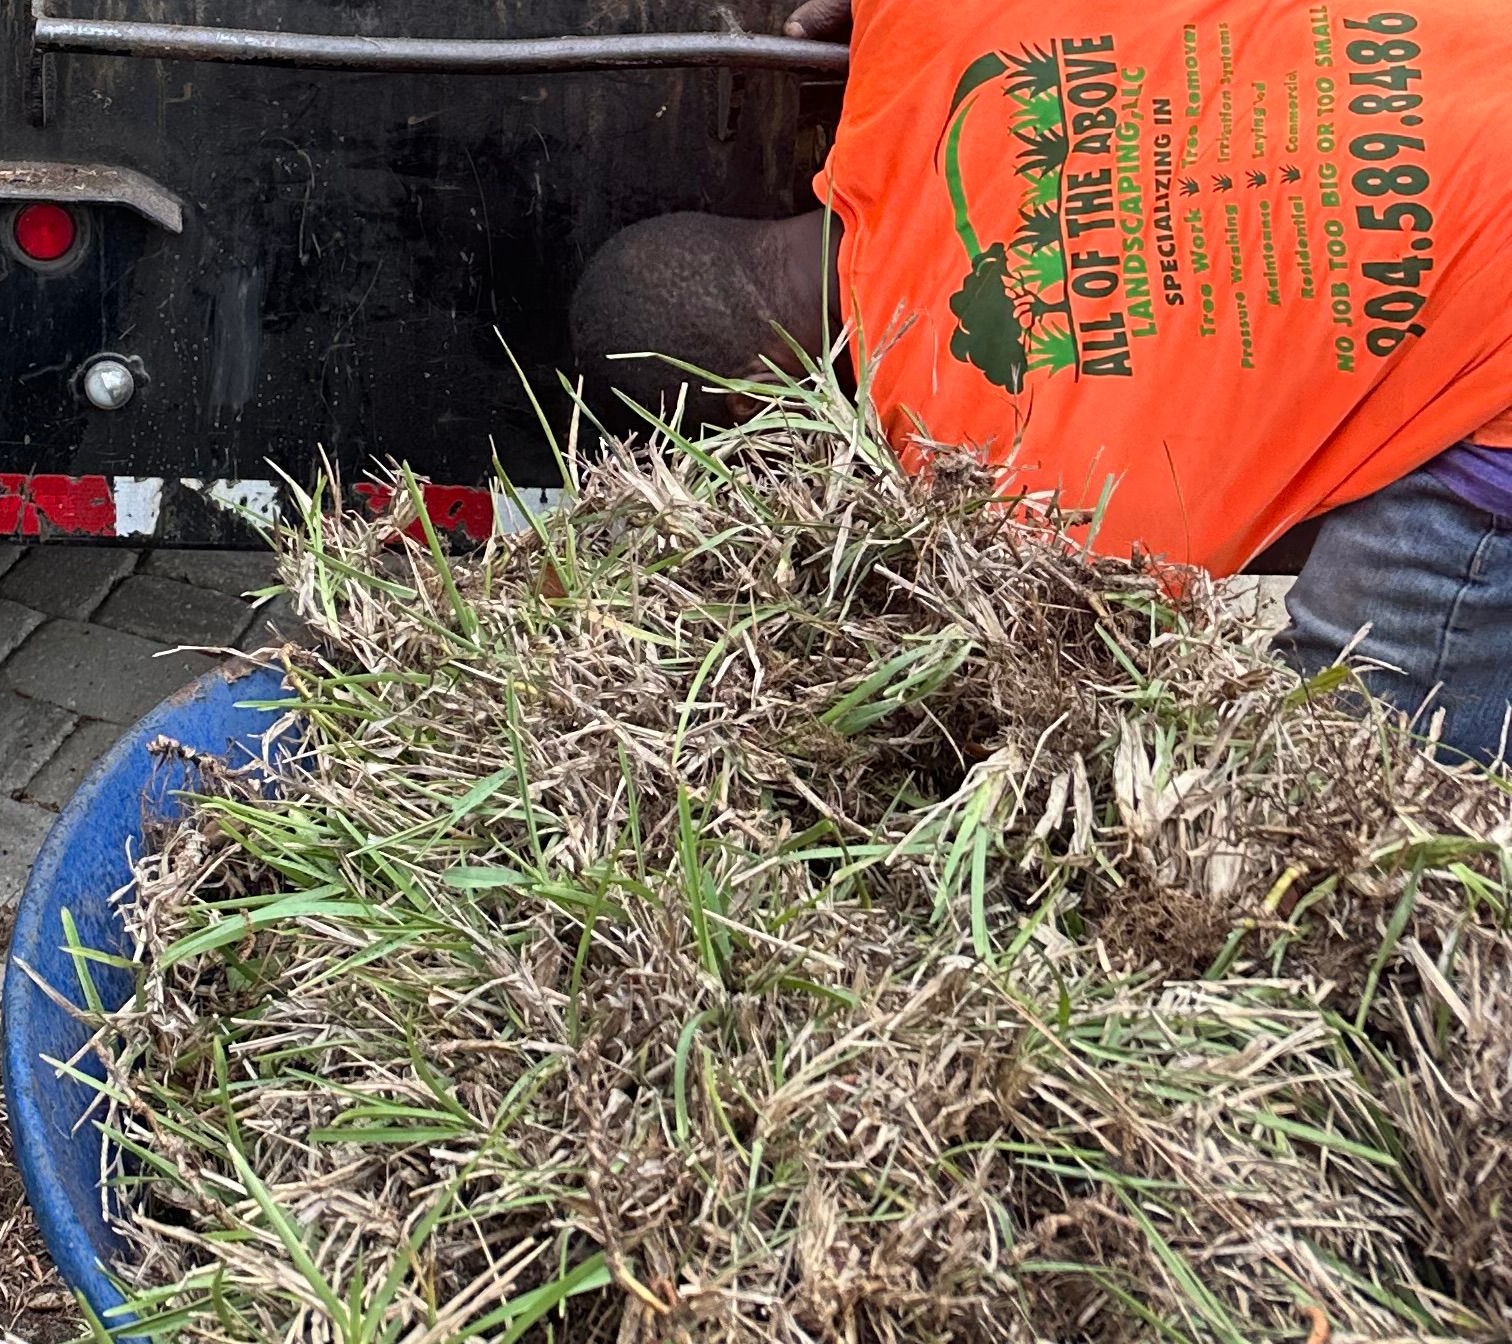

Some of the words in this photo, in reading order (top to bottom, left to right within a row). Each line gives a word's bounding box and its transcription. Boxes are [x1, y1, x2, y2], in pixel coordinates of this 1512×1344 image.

[1218, 23, 1234, 86] Systems
[1309, 5, 1333, 67] SMALL
[1061, 34, 1117, 155] ABOVE
[1183, 24, 1200, 118] Removal
[1315, 77, 1335, 117] TOO
[1152, 98, 1172, 126] IN
[1251, 107, 1267, 159] Laying
[1317, 121, 1335, 153] OR
[1180, 124, 1199, 169] Tree
[1065, 168, 1116, 239] THE
[1318, 163, 1340, 207] BIG
[1343, 12, 1433, 357] 904.589.8486
[1153, 134, 1184, 306] SPECIALIZING
[1183, 208, 1209, 274] Work
[1225, 204, 1243, 284] Washing
[1288, 196, 1314, 299] Residential
[1324, 220, 1348, 272] TOO
[1071, 250, 1120, 299] OF
[1331, 282, 1352, 328] JOB
[1199, 284, 1216, 337] Tree
[1235, 292, 1255, 369] Pressure
[1078, 312, 1133, 376] ALL
[1335, 336, 1355, 373] NO
